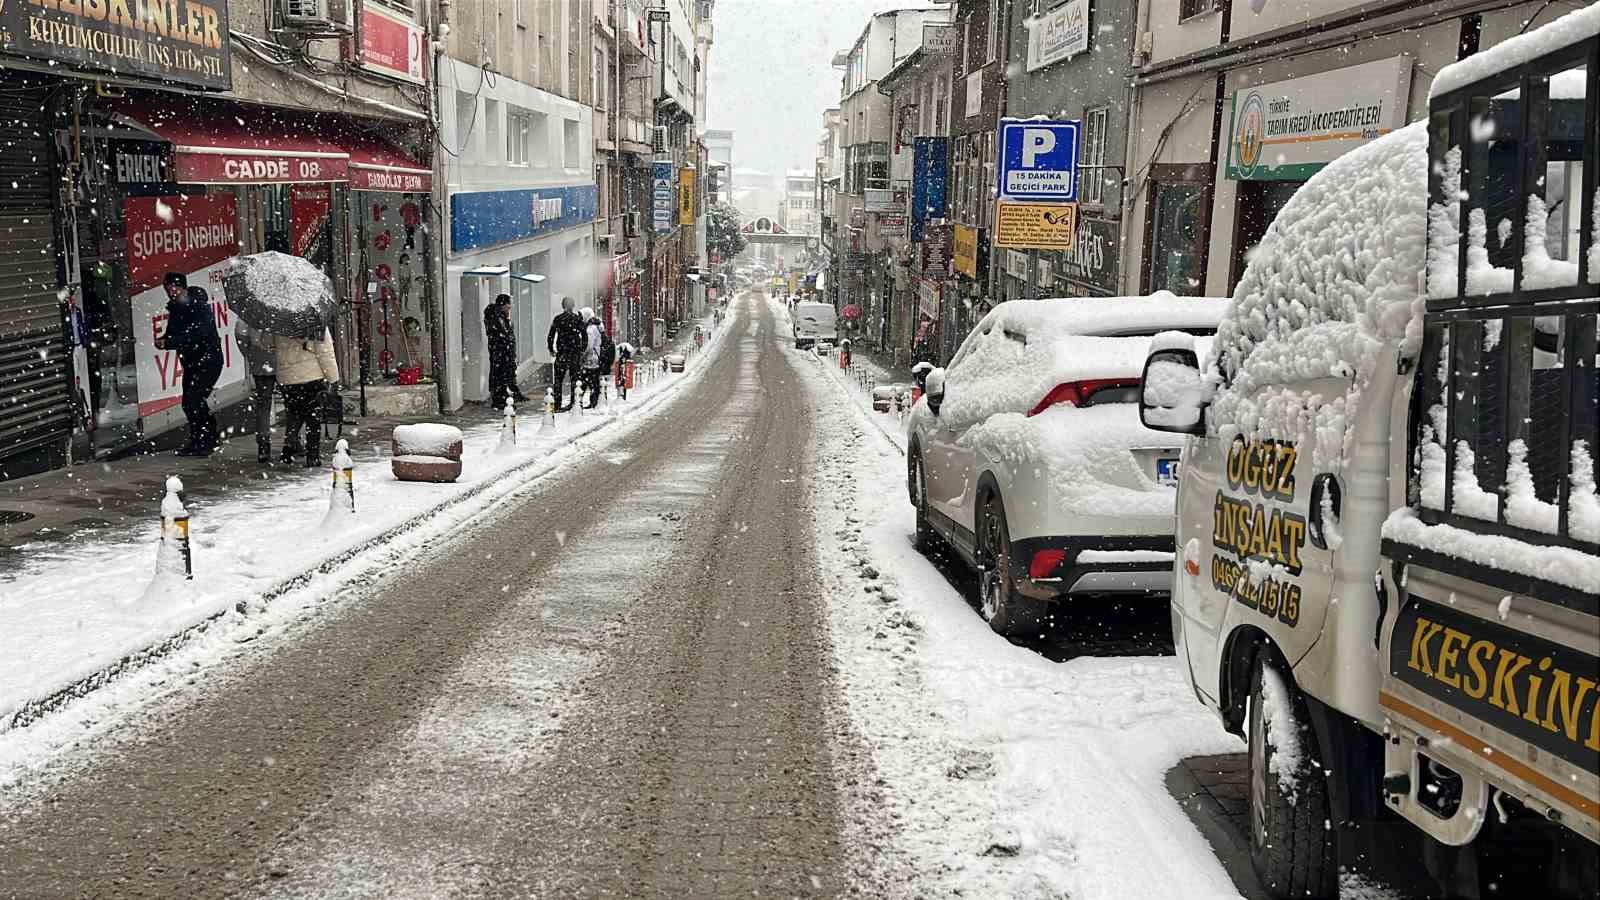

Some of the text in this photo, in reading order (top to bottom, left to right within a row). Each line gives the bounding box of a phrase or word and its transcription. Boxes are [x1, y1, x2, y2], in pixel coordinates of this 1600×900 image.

[29, 16, 144, 59] KUYUMCULUK
[1269, 98, 1290, 114] TÜRKİYE
[1267, 118, 1288, 136] TARIM
[1289, 110, 1312, 134] KREDİ
[1021, 128, 1056, 168] P
[116, 153, 161, 183] ERKEK
[225, 160, 320, 178] CADDE 08
[1015, 172, 1062, 180] 15 DAKİKA
[1009, 183, 1067, 192] GEÇİCİ PARK
[133, 222, 235, 257] SÜPER İNDİRİM
[1262, 580, 1278, 611] 15
[1281, 586, 1299, 622] 15
